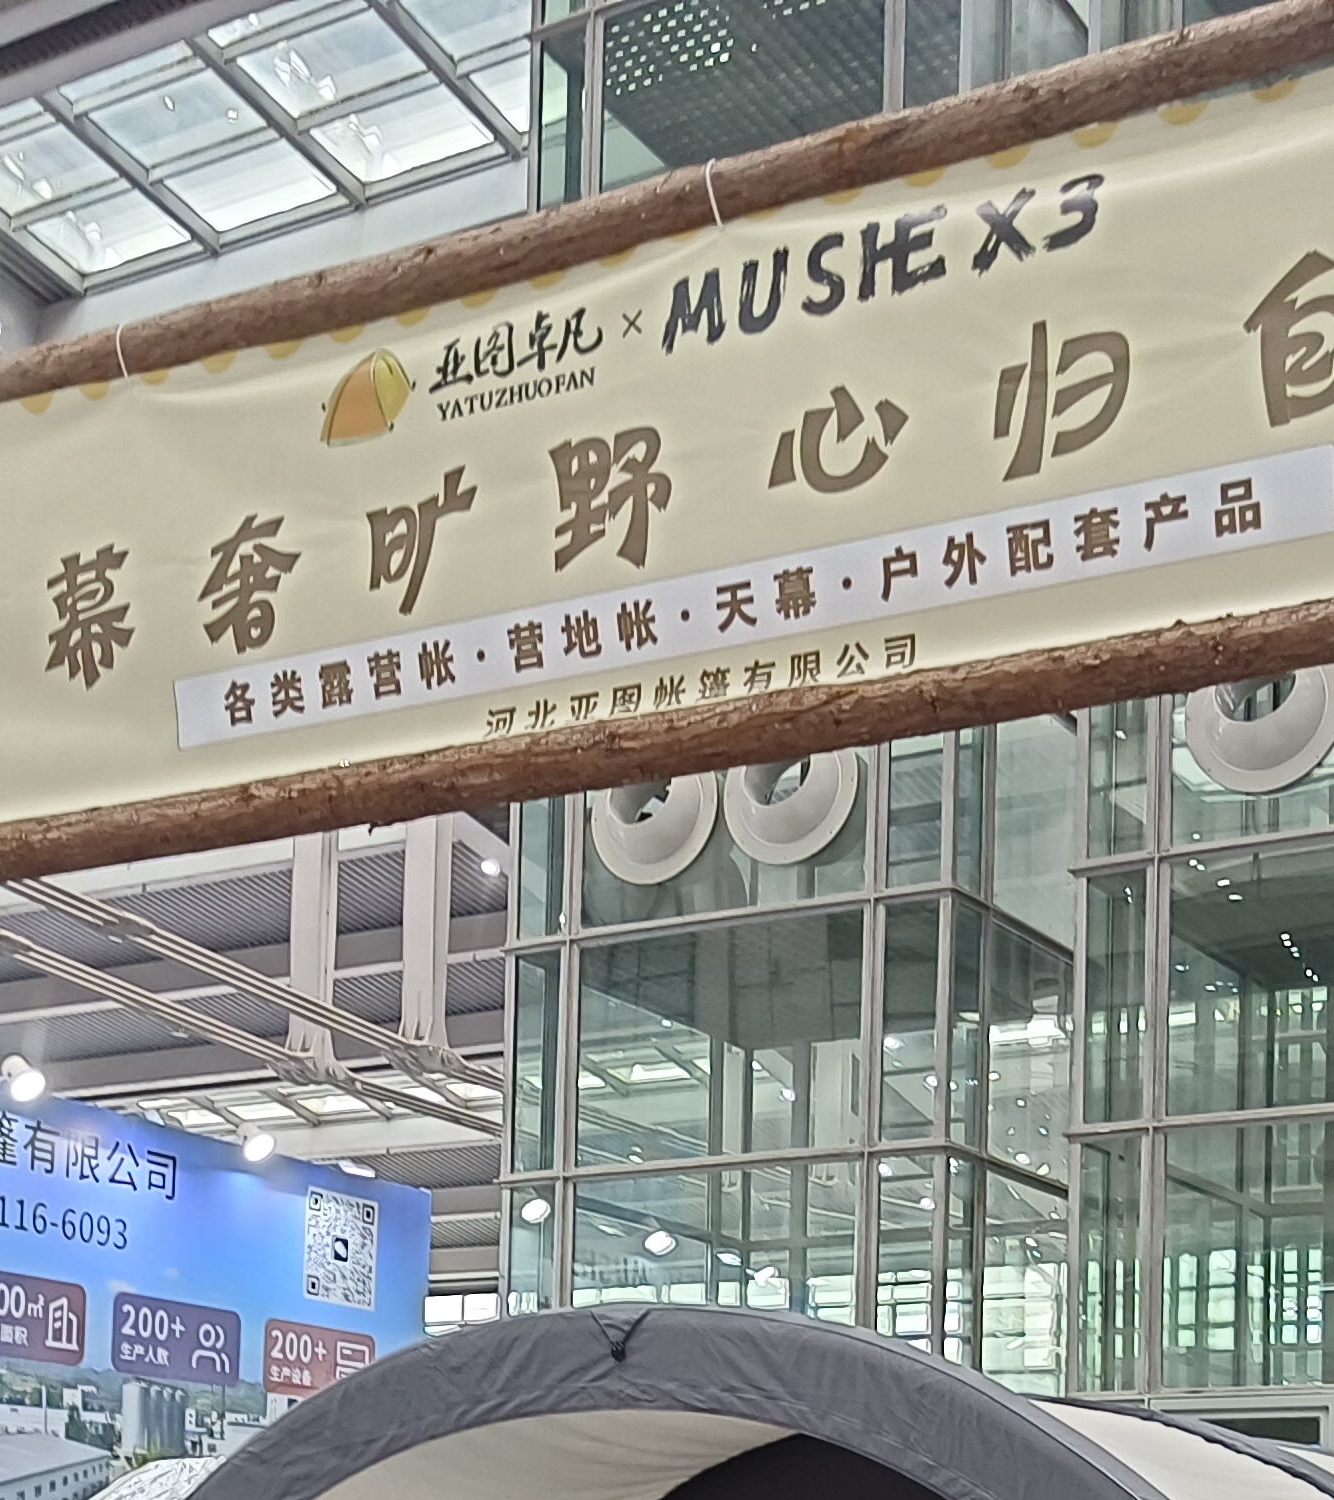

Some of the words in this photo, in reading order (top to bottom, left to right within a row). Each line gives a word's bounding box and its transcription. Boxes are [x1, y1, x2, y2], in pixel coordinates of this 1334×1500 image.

[661, 203, 948, 356] MUSHE
[436, 365, 597, 421] YATUZHUOFAN
[120, 1303, 186, 1342] 200+
[119, 1341, 170, 1368] 生产人数
[270, 1328, 328, 1364] 200+
